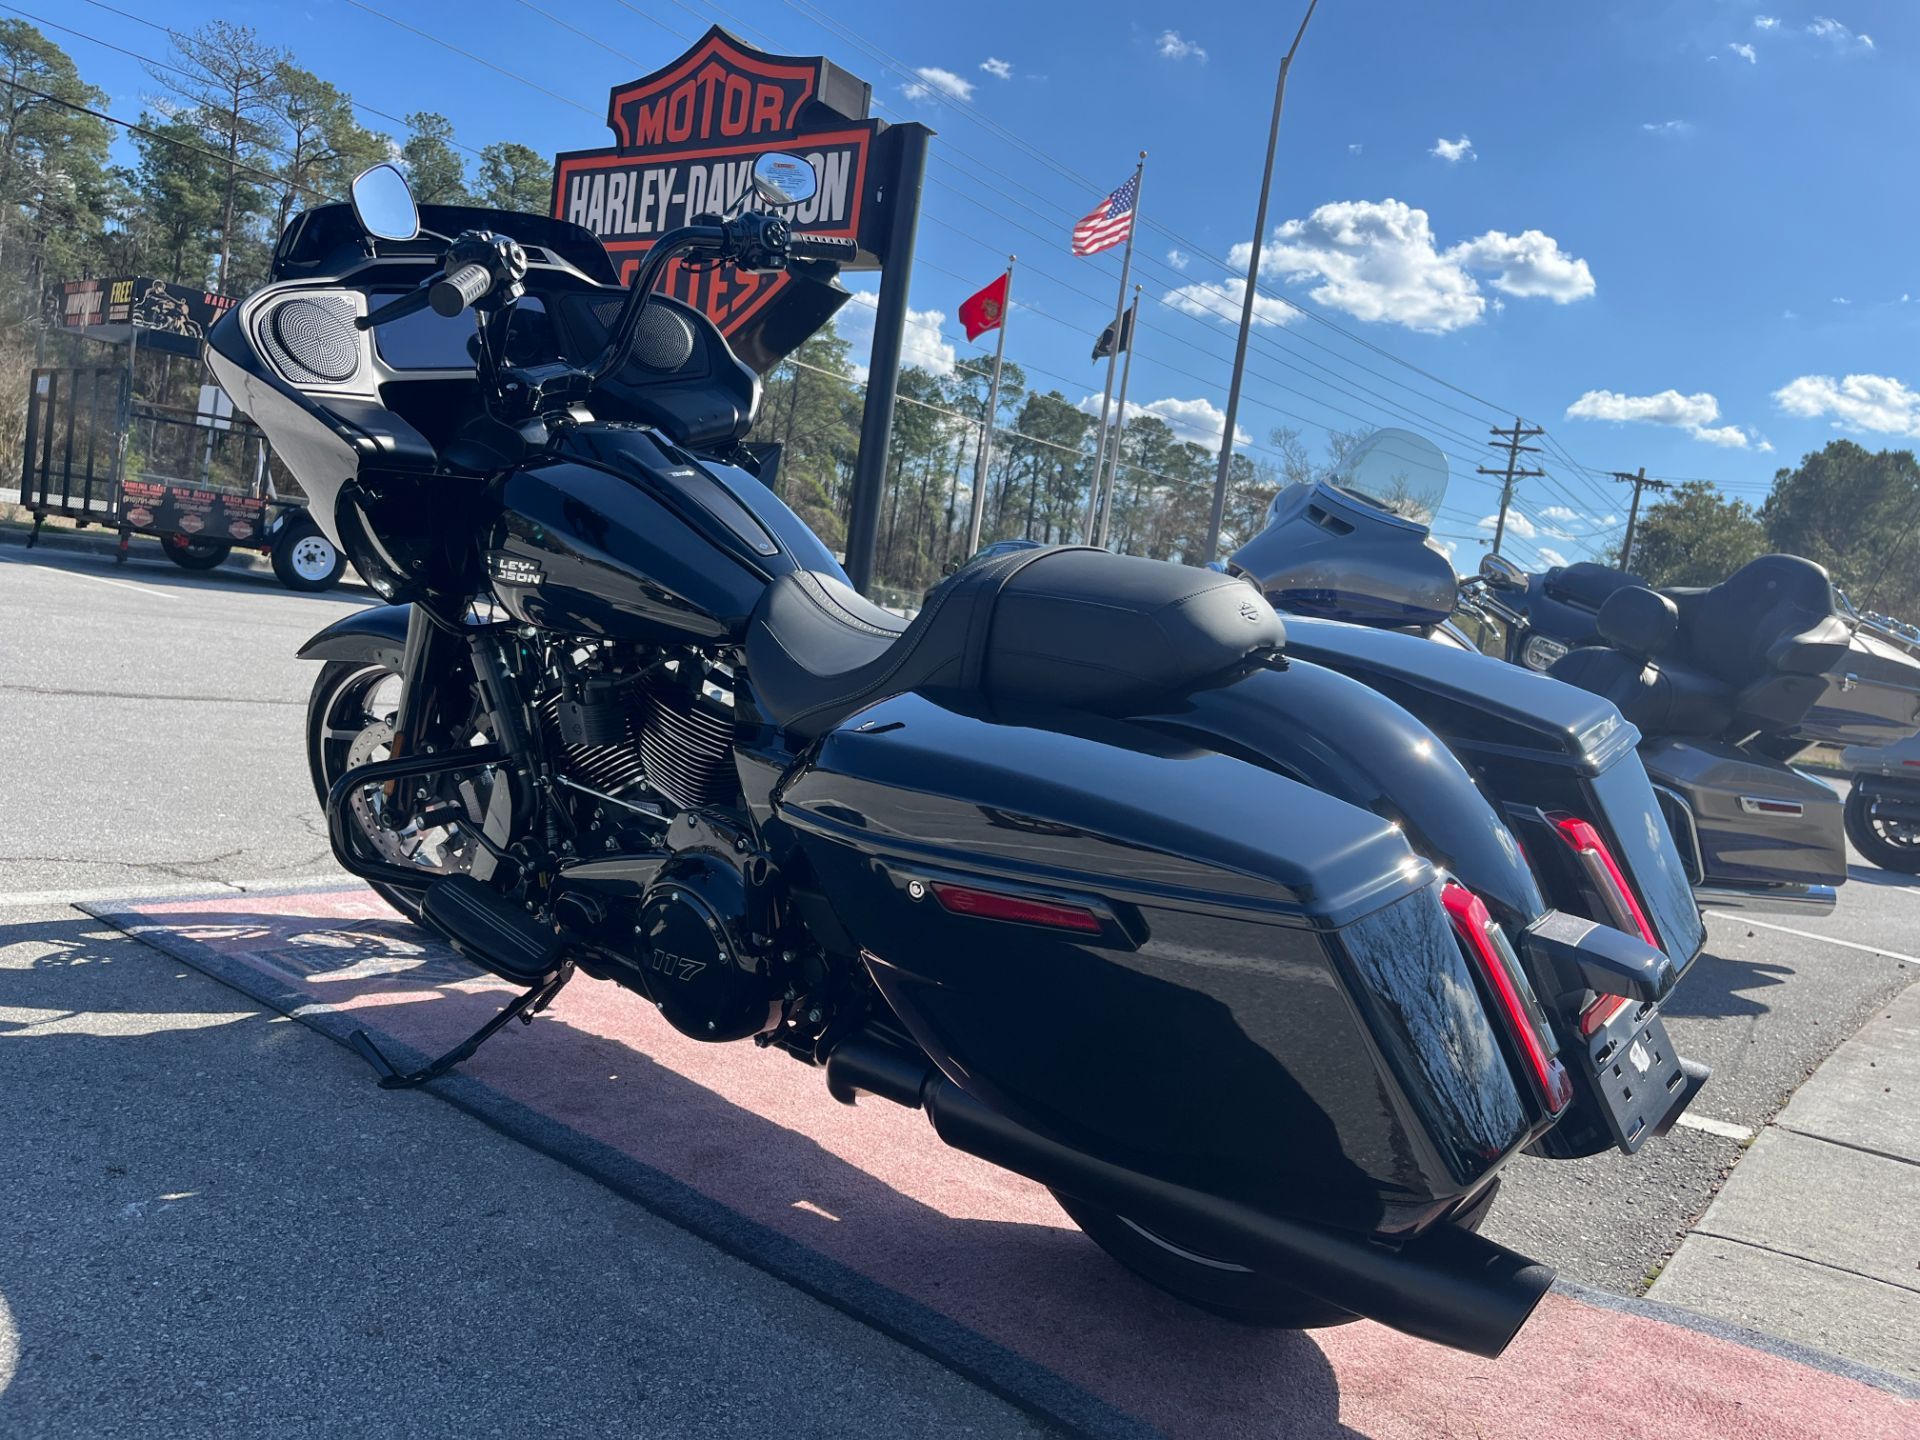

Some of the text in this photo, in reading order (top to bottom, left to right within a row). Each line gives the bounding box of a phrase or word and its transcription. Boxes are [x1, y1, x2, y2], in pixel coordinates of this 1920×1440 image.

[636, 61, 785, 147] MOTOR
[568, 151, 851, 237] HARLEY-DAVON
[110, 280, 134, 304] FREE!
[620, 257, 760, 326] CLES
[652, 948, 707, 982] 117
